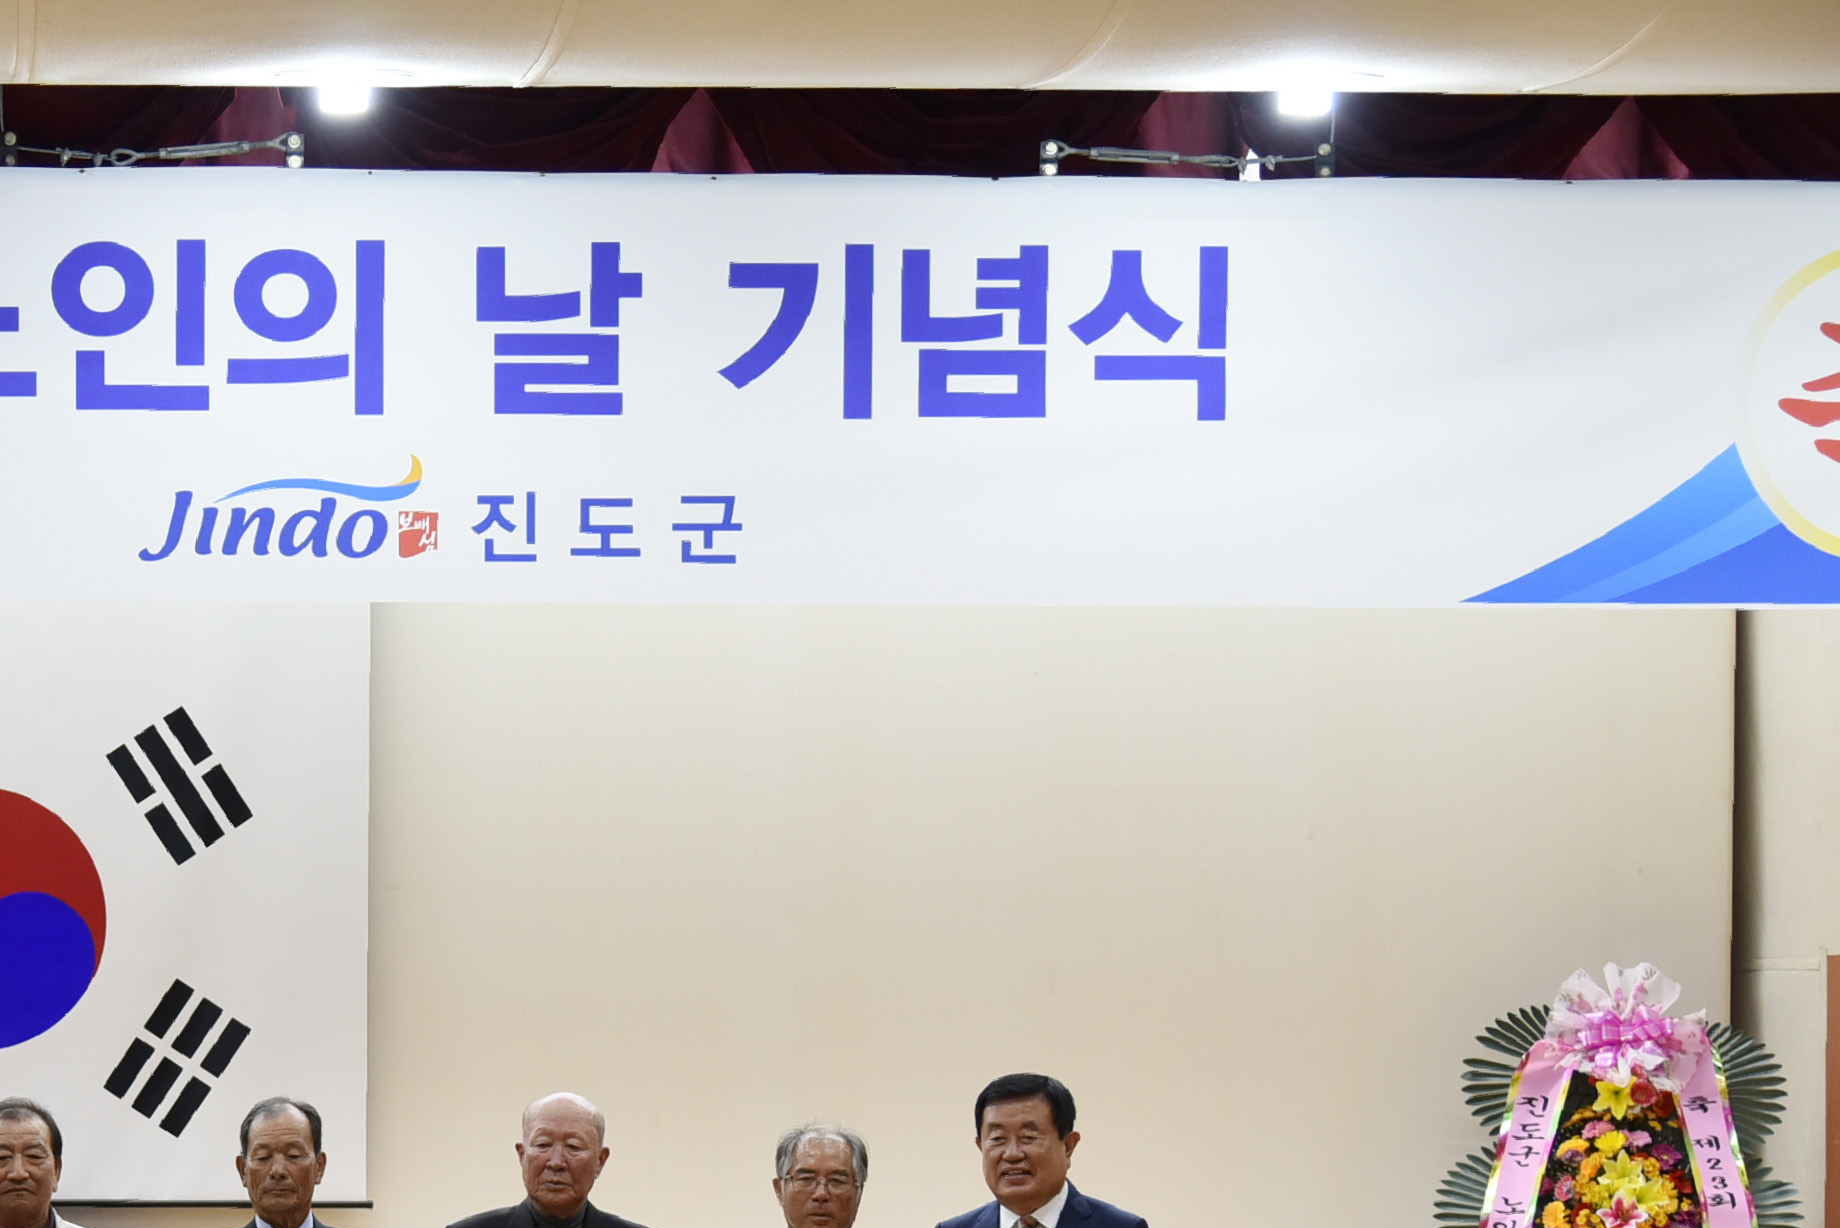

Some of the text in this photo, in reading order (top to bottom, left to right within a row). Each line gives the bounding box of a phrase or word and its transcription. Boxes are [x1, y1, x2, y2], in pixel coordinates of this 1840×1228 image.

[477, 242, 643, 416] 날
[719, 244, 1229, 421] 기념식
[138, 489, 389, 562] Jindo
[471, 490, 743, 565] 진도군
[1506, 1094, 1550, 1168] 진도군
[1692, 1135, 1737, 1210] 제23회
